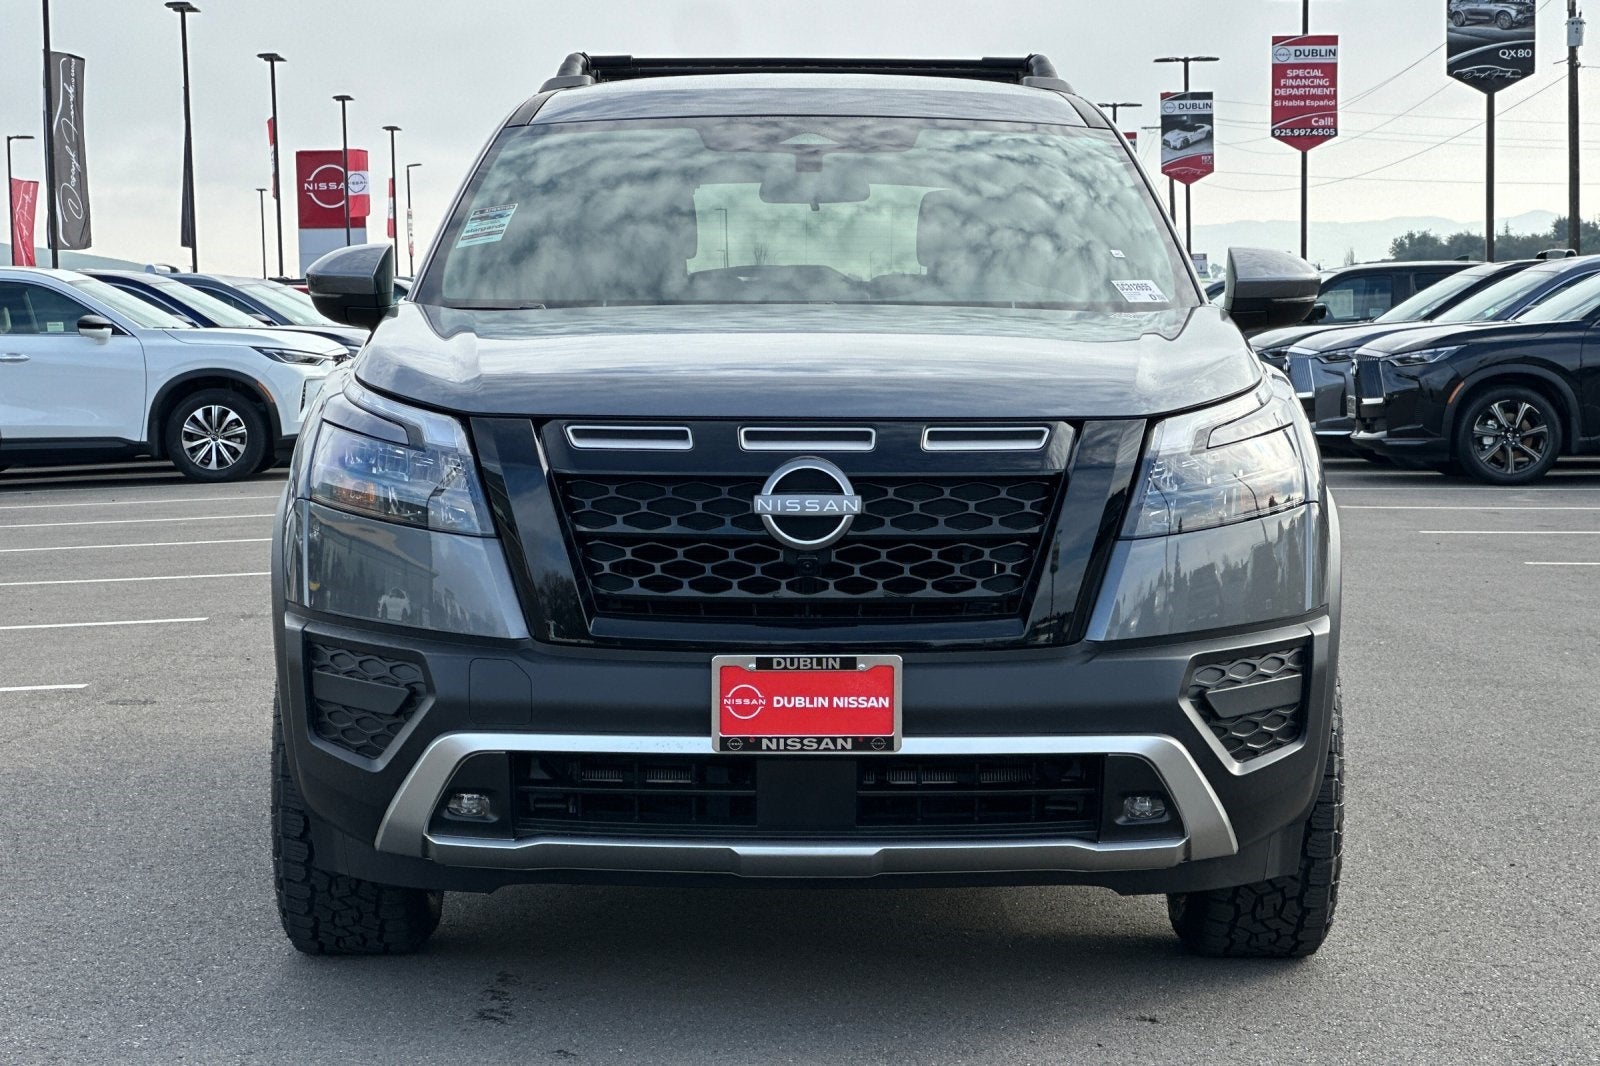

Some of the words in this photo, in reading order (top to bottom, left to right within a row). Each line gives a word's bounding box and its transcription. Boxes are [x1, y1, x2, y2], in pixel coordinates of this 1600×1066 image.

[1294, 49, 1336, 57] DUBLIN
[1498, 49, 1532, 59] QX80
[1286, 69, 1324, 77] SPECIAL
[1178, 102, 1212, 110] DUBLIN
[1311, 117, 1334, 126] Call!
[756, 499, 858, 512] NISSAN
[772, 658, 840, 670] DUBLIN
[773, 696, 829, 708] DUBLIN
[833, 696, 889, 708] NISSAN
[761, 737, 852, 750] NISSAN
